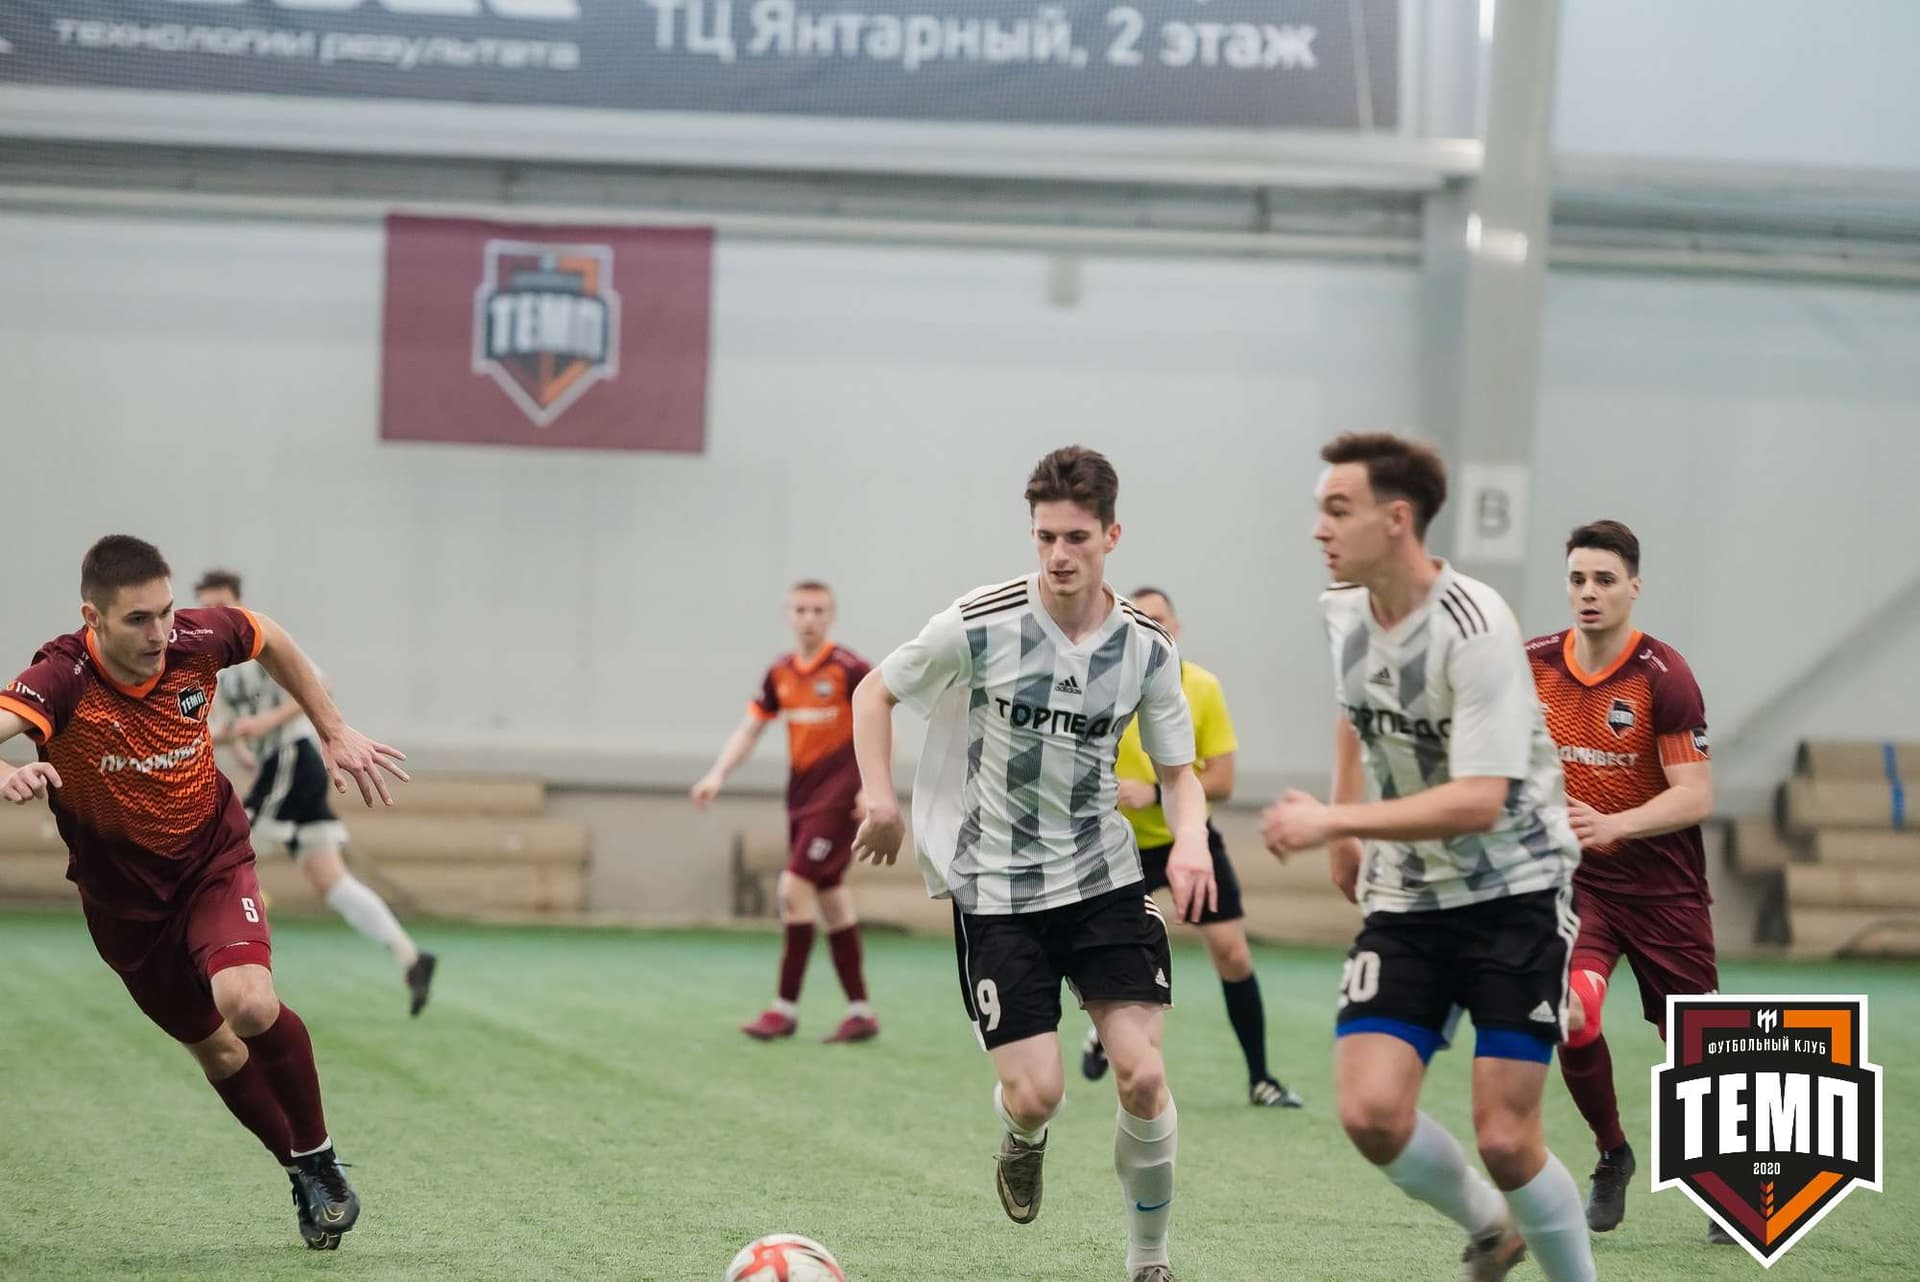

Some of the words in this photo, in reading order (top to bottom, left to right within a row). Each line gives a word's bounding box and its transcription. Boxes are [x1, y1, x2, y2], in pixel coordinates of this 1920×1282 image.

[1106, 5, 1146, 67] 2
[1159, 20, 1319, 70] этаж
[241, 897, 259, 923] 5
[976, 978, 1001, 1031] 9
